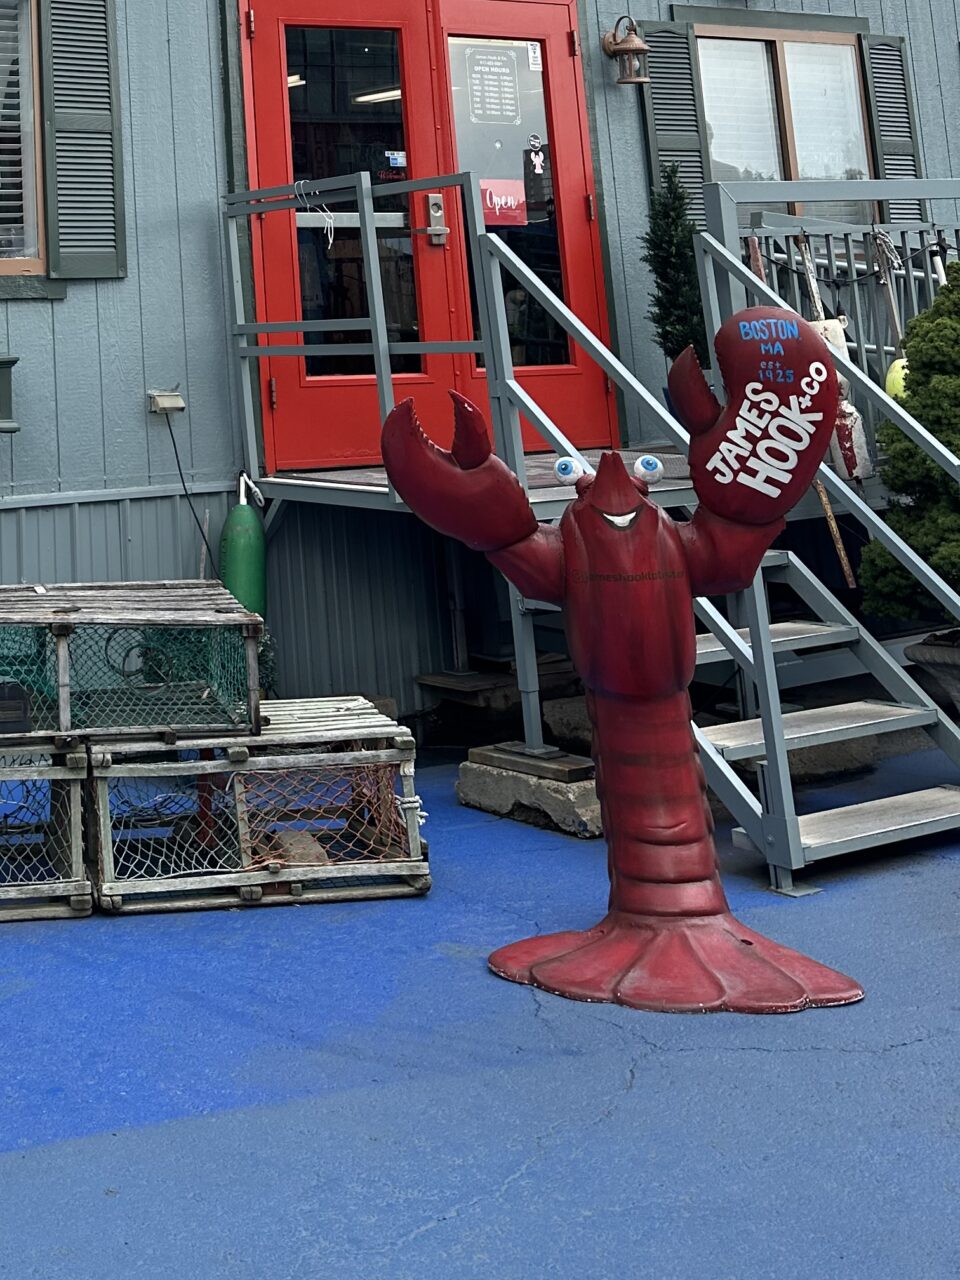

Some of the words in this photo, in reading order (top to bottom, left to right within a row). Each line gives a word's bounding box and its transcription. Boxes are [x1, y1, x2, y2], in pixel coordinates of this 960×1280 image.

[486, 188, 519, 216] Open
[760, 341, 785, 357] MA
[758, 370, 795, 383] 1925
[706, 381, 780, 484] JAMES
